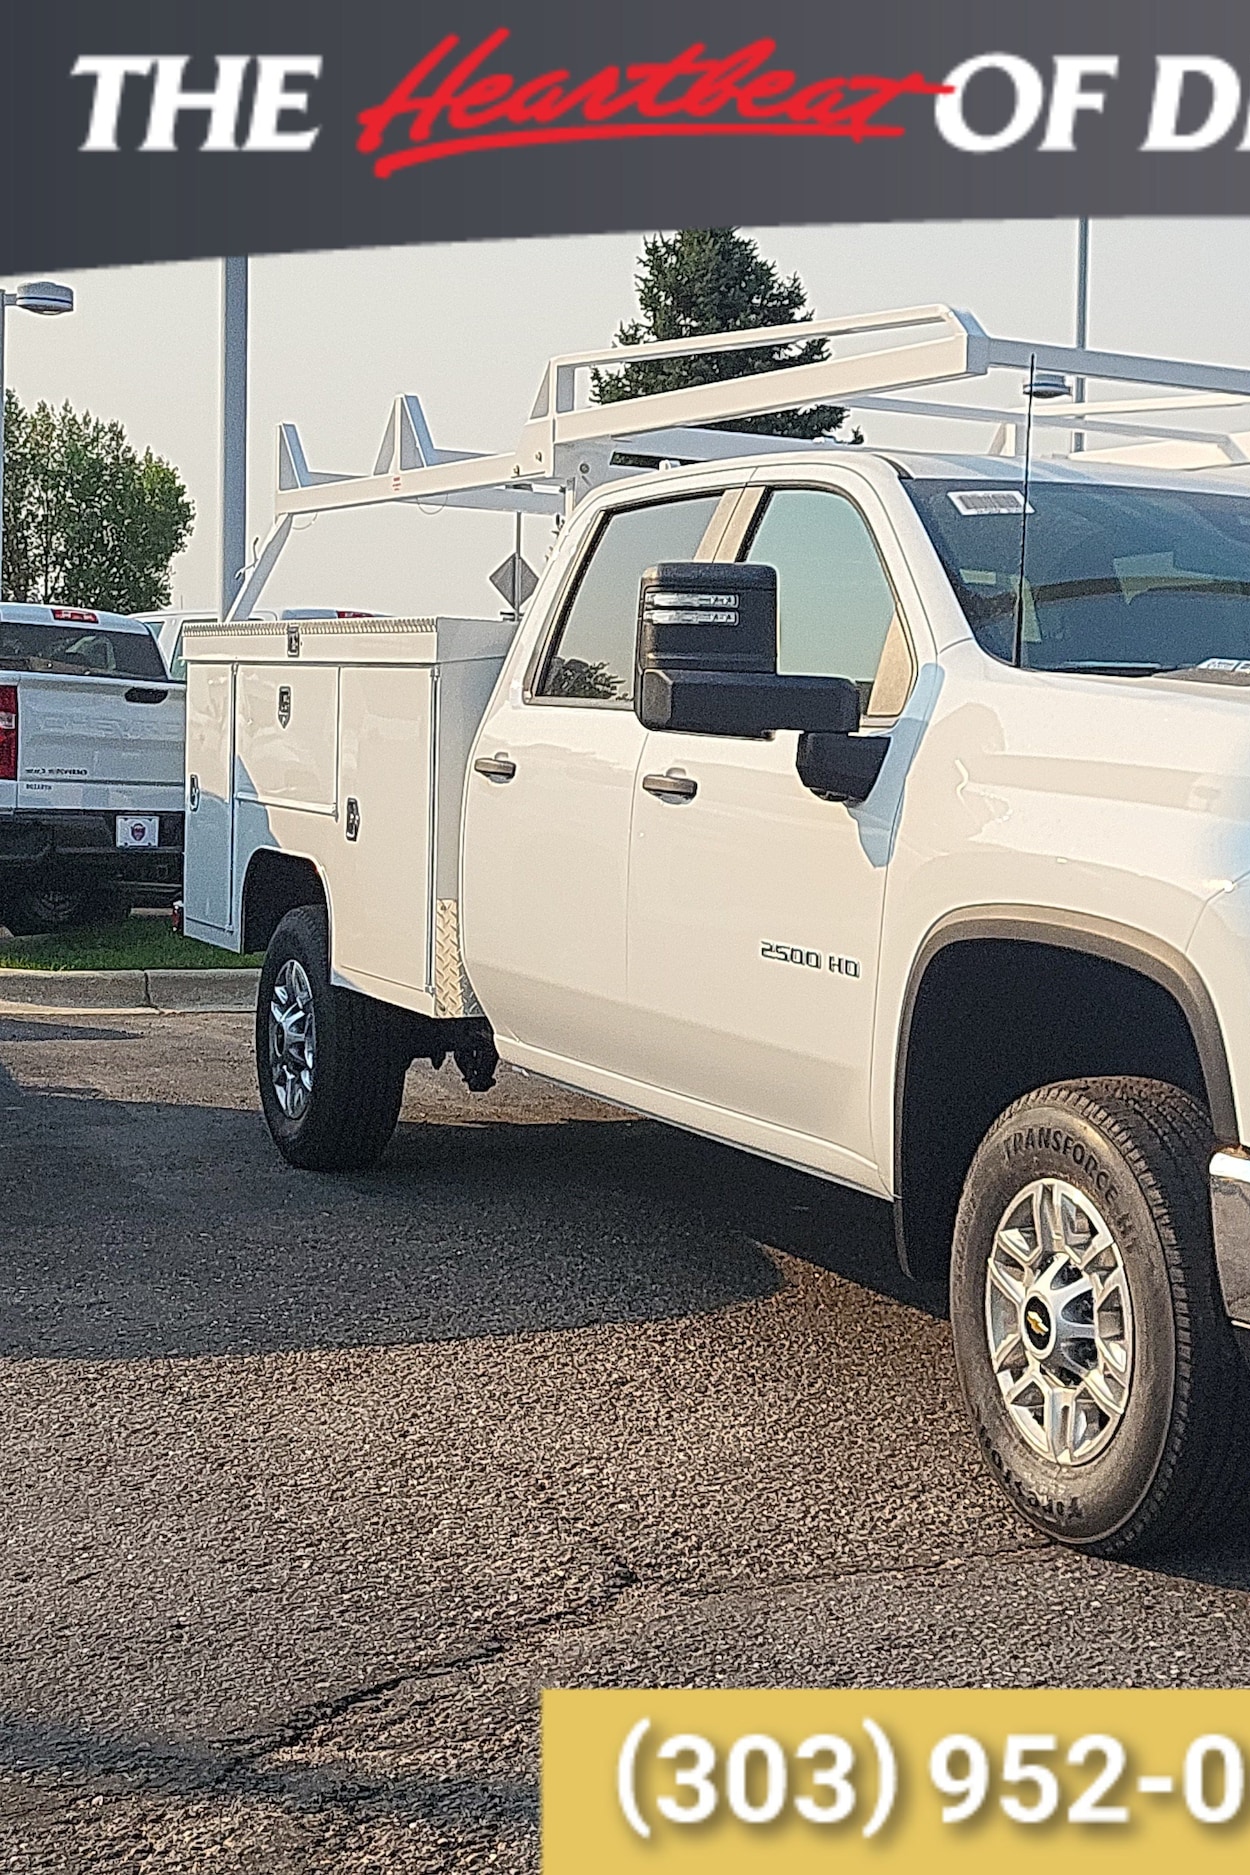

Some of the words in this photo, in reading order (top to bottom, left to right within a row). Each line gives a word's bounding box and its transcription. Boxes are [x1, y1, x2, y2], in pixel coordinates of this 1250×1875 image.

[760, 940, 821, 969] 2500
[828, 955, 860, 978] HD
[1003, 1127, 1119, 1206] TRANSFORCE
